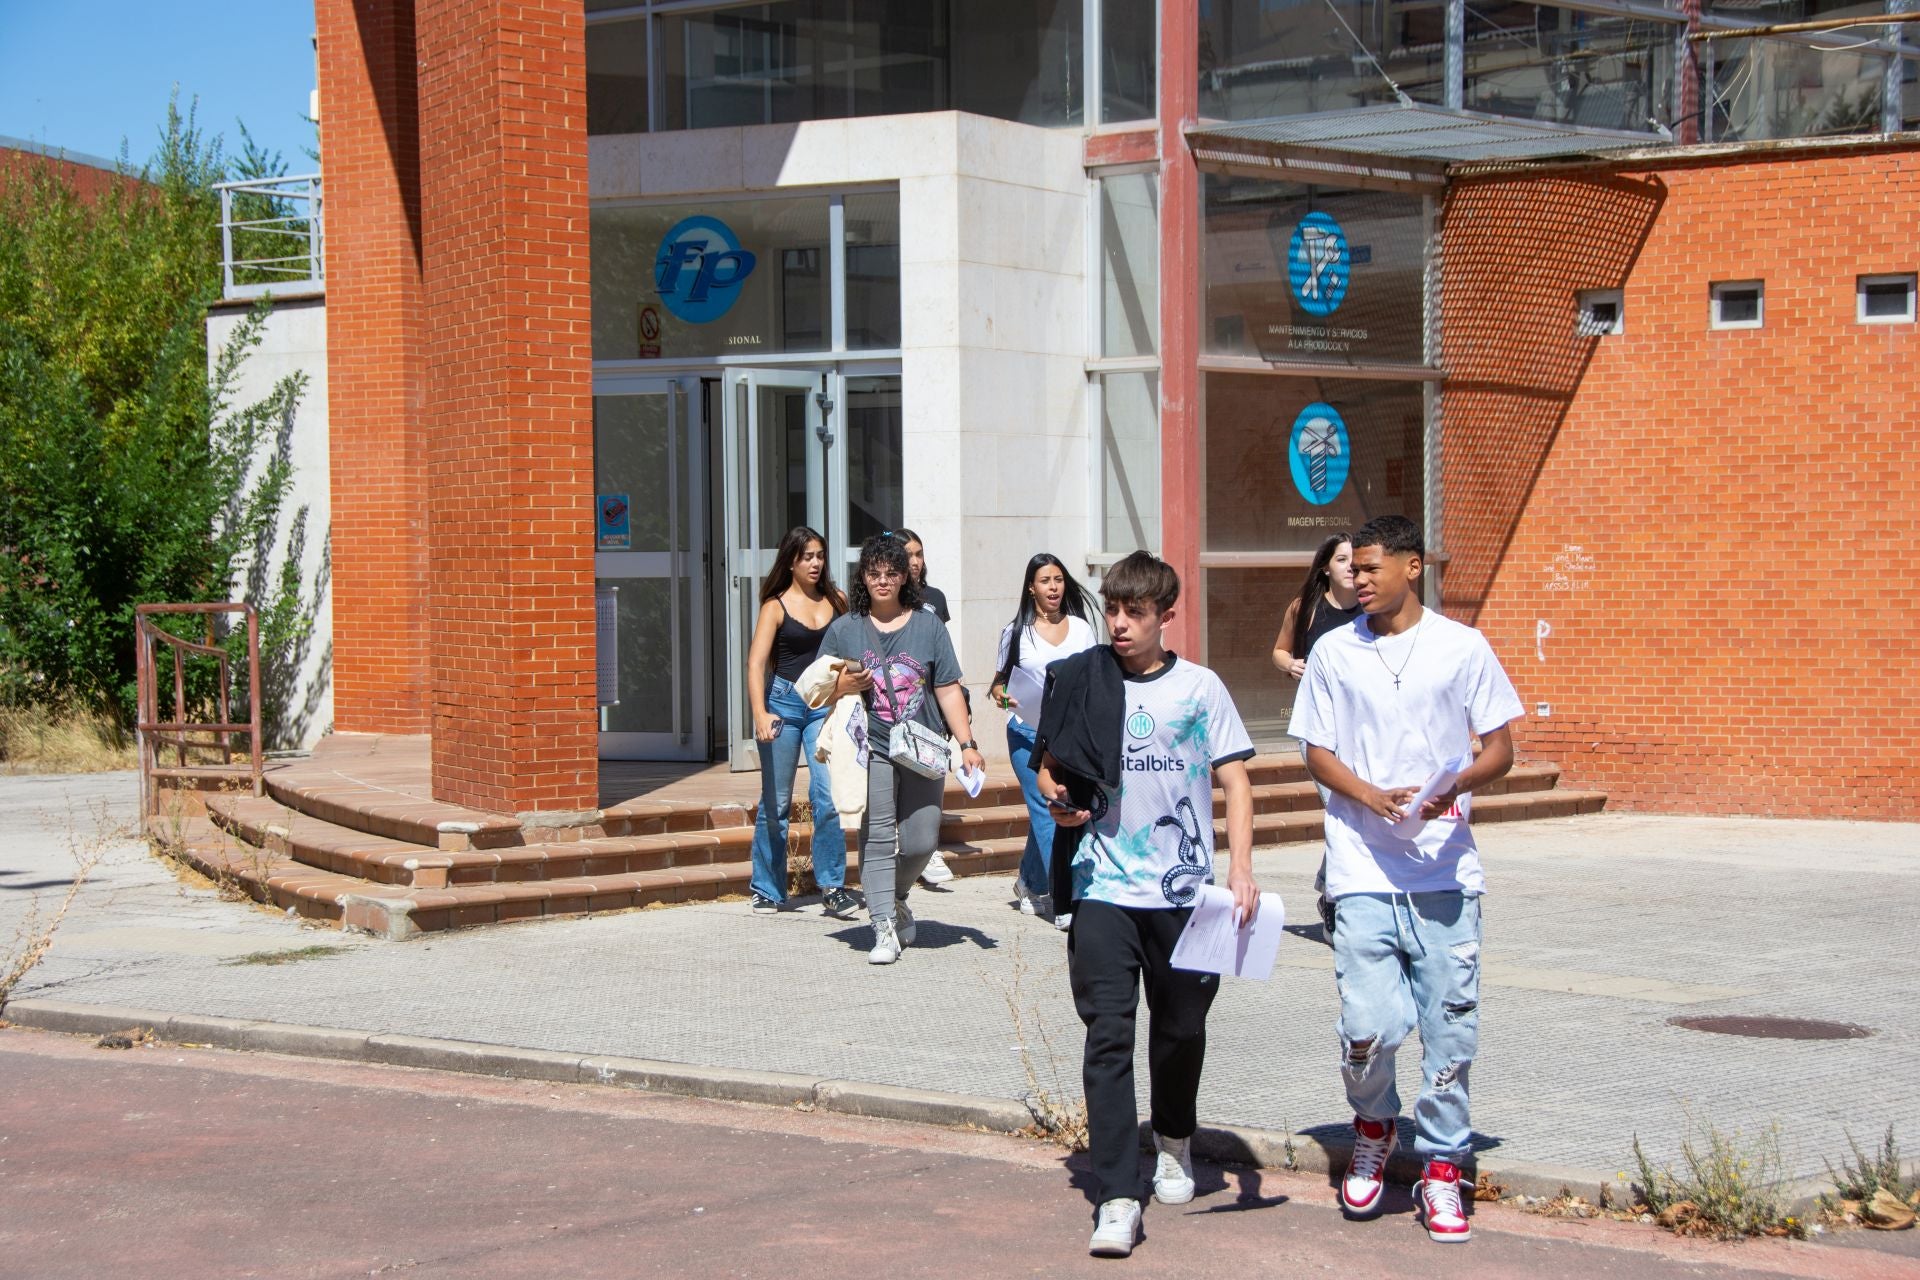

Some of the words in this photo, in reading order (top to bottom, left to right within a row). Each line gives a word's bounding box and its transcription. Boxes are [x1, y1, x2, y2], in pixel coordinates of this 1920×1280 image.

[1332, 328, 1368, 339] SERVICIOS
[1287, 517, 1314, 527] IMAGEN
[1315, 516, 1352, 527] PERSONAL
